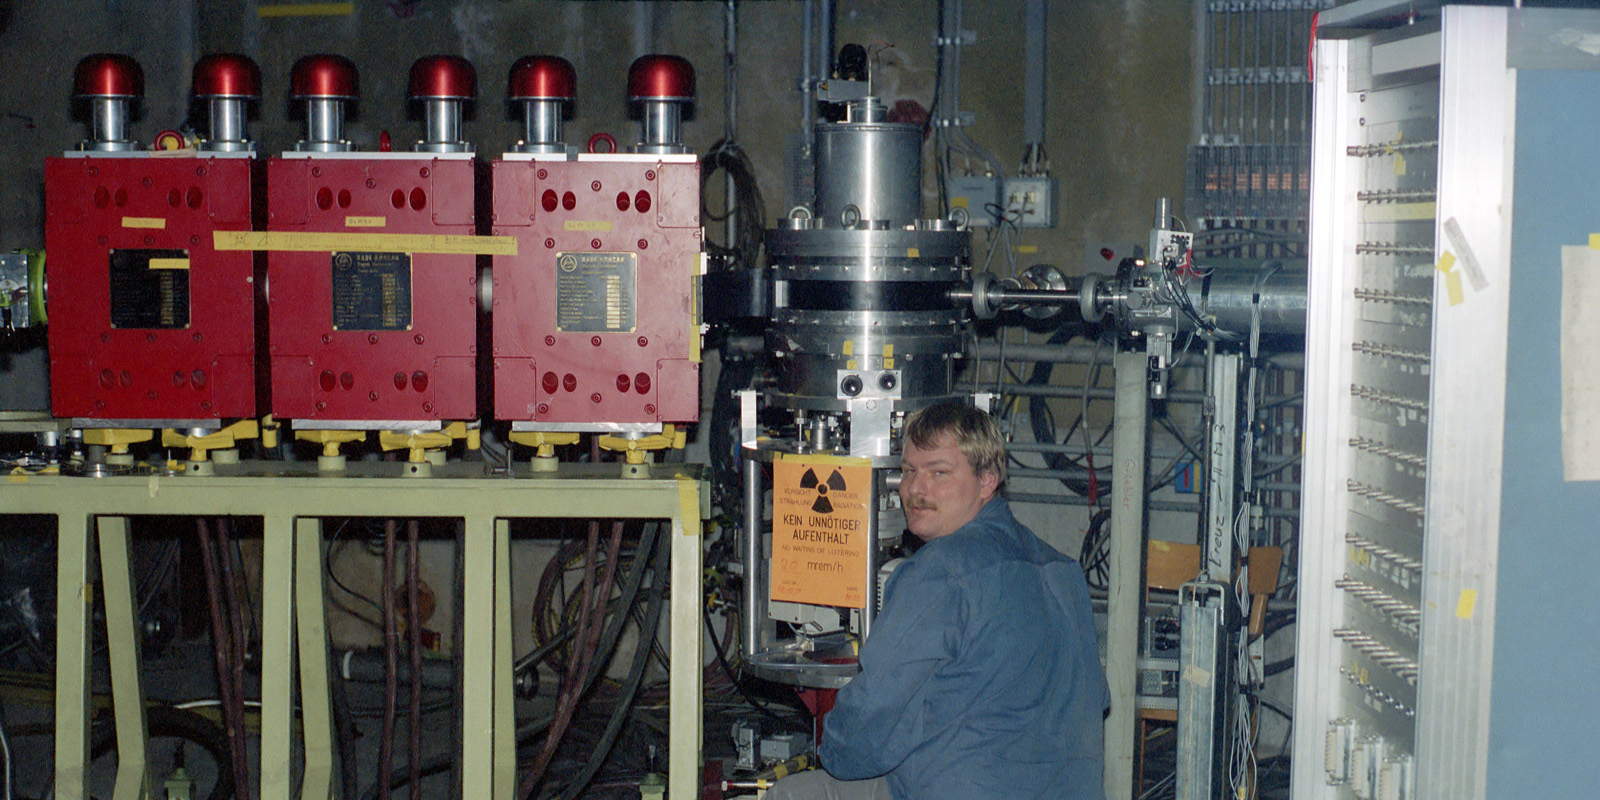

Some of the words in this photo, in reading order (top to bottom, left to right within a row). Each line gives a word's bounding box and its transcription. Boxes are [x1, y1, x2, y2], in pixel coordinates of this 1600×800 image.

[832, 491, 858, 500] DANGER
[779, 498, 812, 507] STRAHLUNG
[832, 502, 864, 510] RADIATION
[783, 514, 803, 526] KEIN
[808, 516, 861, 531] UNNÖTIGER
[792, 530, 850, 545] AUFENTHALT
[792, 546, 815, 554] WAITING
[828, 549, 860, 557] LOITERING
[807, 561, 844, 573] mrem/h
